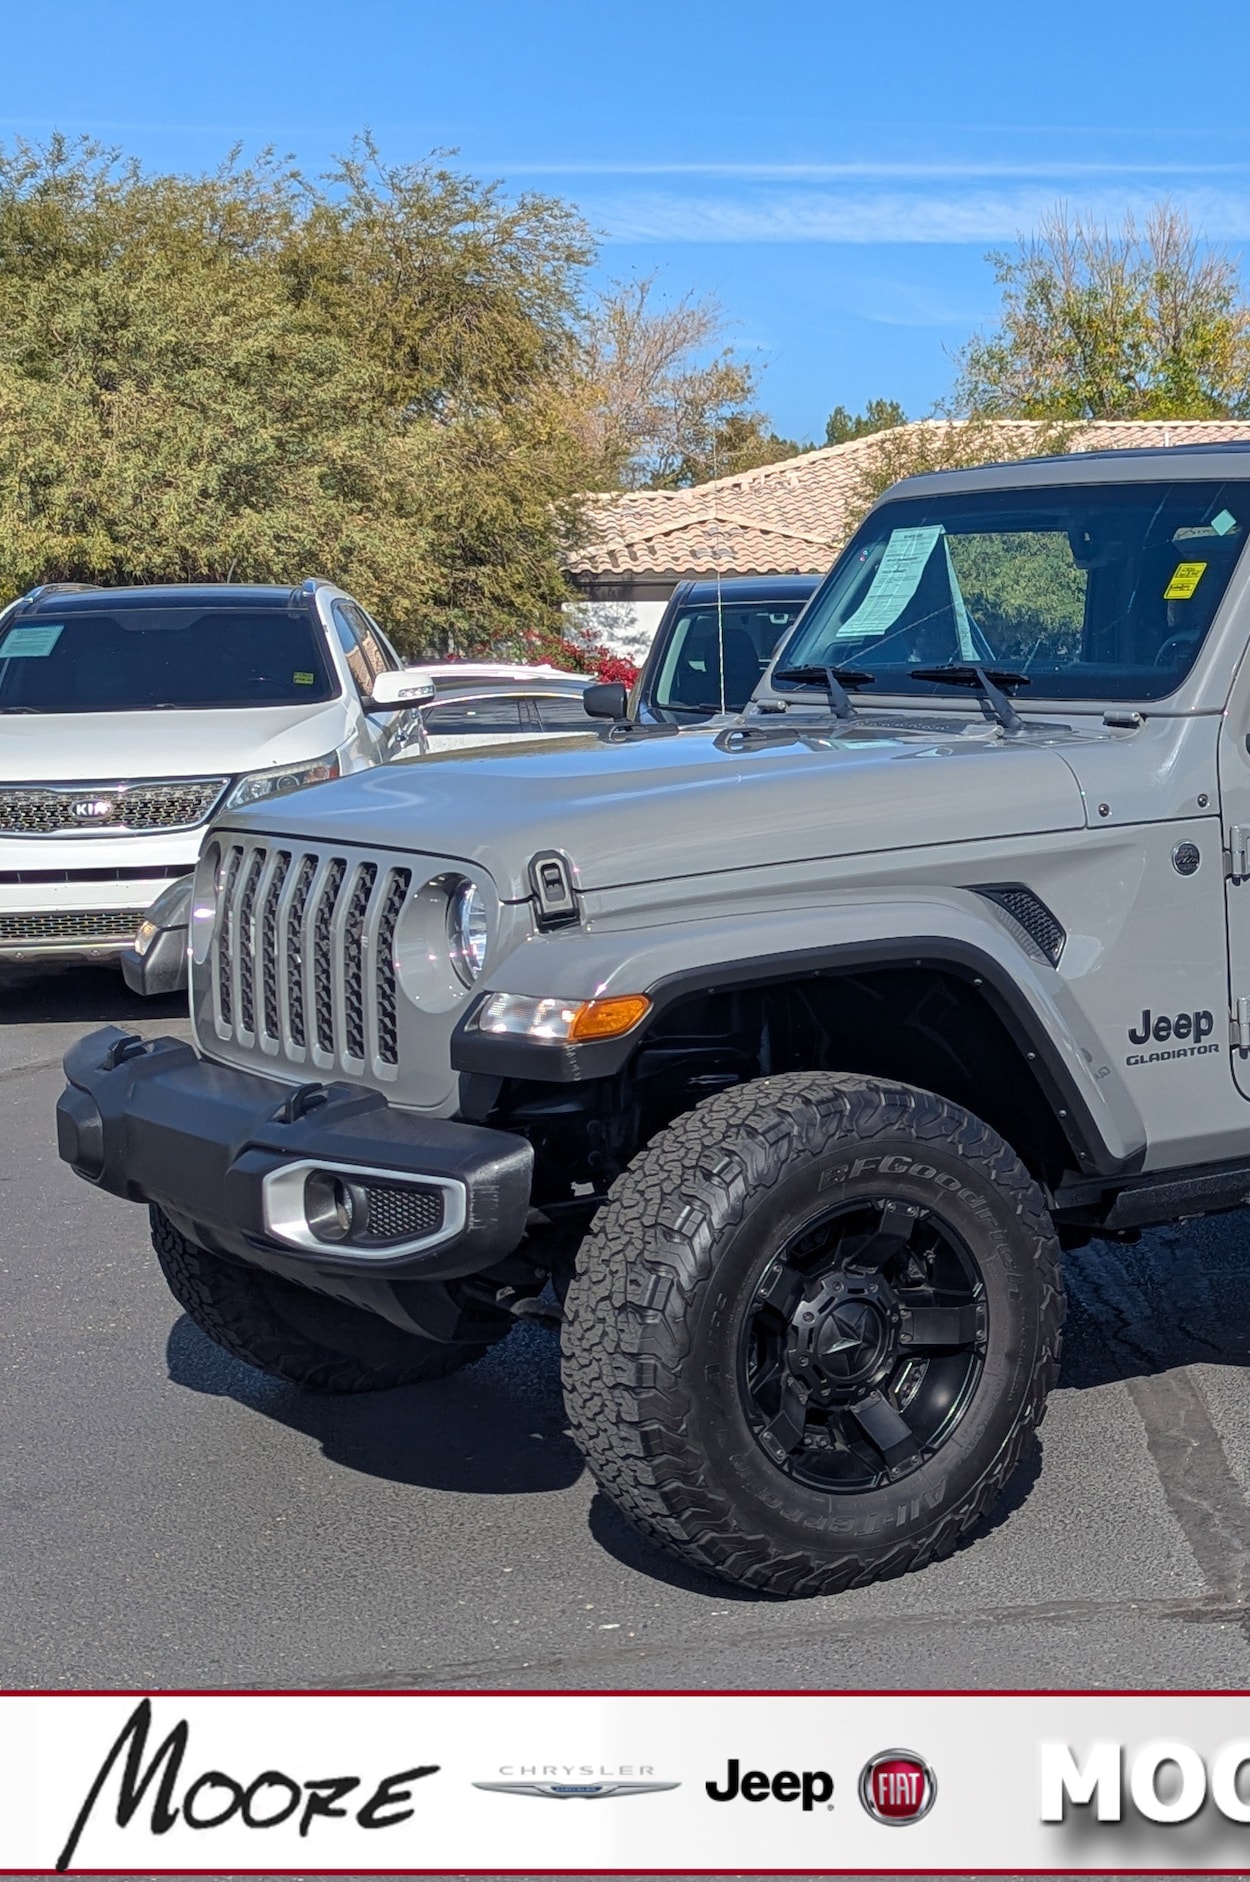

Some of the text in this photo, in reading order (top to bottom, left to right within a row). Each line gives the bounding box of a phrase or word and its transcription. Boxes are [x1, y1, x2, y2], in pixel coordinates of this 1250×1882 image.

[75, 802, 108, 816] KIA
[1128, 1007, 1214, 1045] Jeep
[1126, 1043, 1220, 1067] GLADIATOR
